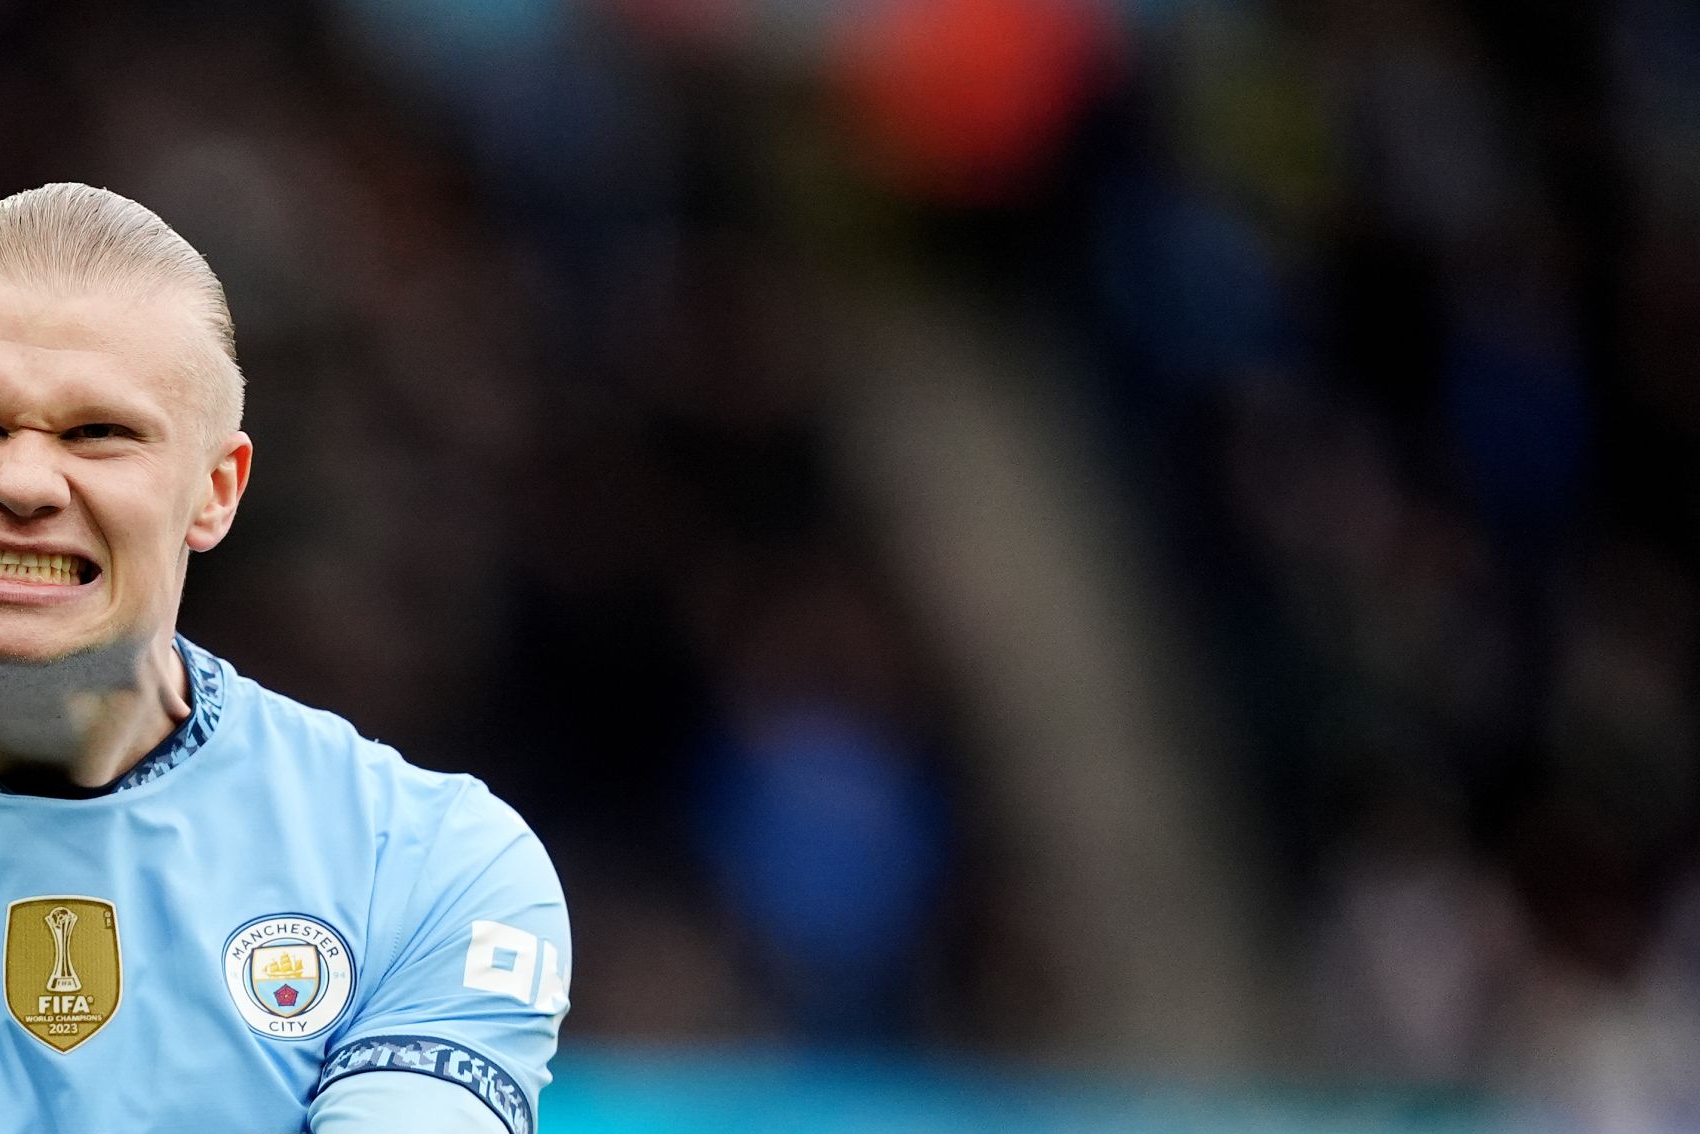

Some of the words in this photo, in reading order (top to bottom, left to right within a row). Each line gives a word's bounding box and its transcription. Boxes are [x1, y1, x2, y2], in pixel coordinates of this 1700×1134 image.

[232, 923, 340, 961] MANCHESTER
[49, 1023, 78, 1034] 2023
[269, 1021, 308, 1032] CITY
